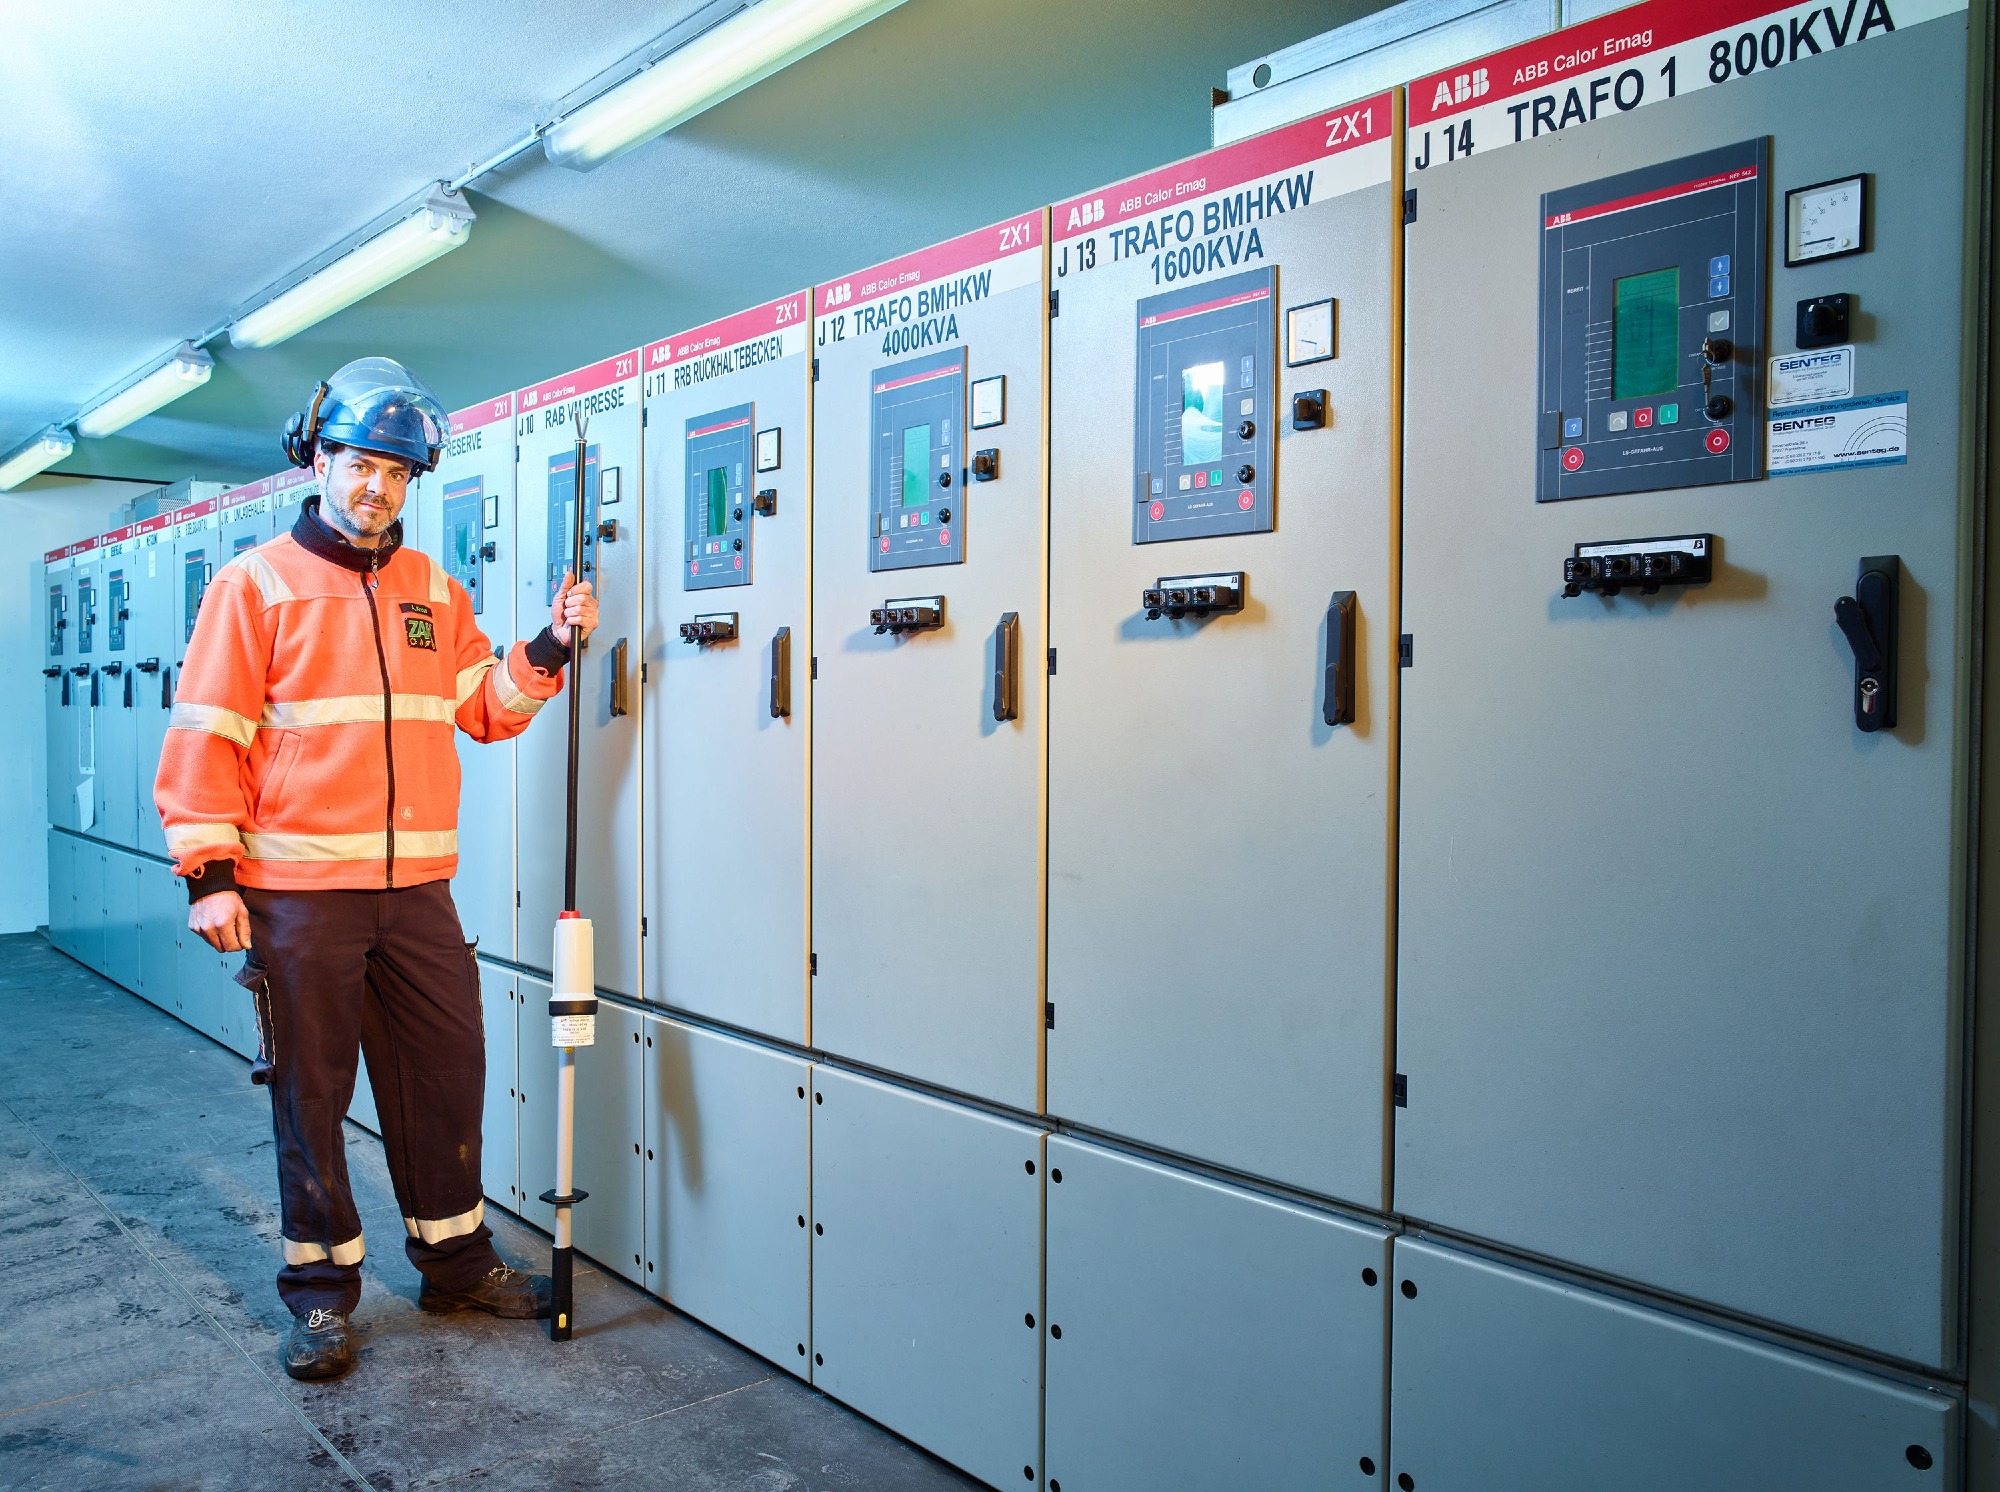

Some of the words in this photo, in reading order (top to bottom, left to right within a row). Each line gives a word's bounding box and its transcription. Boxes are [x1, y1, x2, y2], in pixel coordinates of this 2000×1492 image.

[1415, 132, 1430, 170] J
[1444, 118, 1474, 163] 14
[1507, 68, 1644, 143] TRAFO
[1660, 55, 1677, 97] 1
[1708, 0, 1896, 84] 800KVA
[1431, 67, 1490, 112] ABB
[1512, 60, 1549, 87] ABB
[1553, 46, 1598, 72] Calor
[1603, 28, 1653, 57] Emag
[1325, 107, 1373, 148] ZX1
[1067, 198, 1105, 231] ABB
[1119, 197, 1142, 214] ABB
[1144, 188, 1173, 206] Calor
[1176, 177, 1206, 199] Emag
[1553, 213, 1572, 225] ABB
[999, 221, 1030, 251] ZX1
[1057, 246, 1068, 277] J
[1077, 237, 1096, 271] 13
[1109, 210, 1195, 262] TRAFO
[1203, 170, 1315, 237] BMHKW
[1151, 227, 1264, 285] 1600KVA
[825, 283, 851, 308] ABB
[861, 284, 877, 297] ABB
[878, 277, 897, 291] Calor
[900, 269, 920, 285] Emag
[775, 300, 798, 325] ZX1
[818, 321, 826, 346] J
[831, 315, 845, 342] 12
[854, 295, 912, 335] TRAFO
[918, 269, 992, 318] BMHKW
[652, 344, 671, 366] ABB
[677, 346, 690, 357] ABB
[690, 341, 704, 354] Calor
[705, 336, 720, 347] Emag
[882, 313, 959, 357] 4000KVA
[616, 358, 632, 378] ZX1
[1780, 354, 1841, 370] SENTEG
[646, 376, 652, 398] J
[656, 372, 665, 395] 11
[674, 364, 691, 390] RRB
[494, 401, 508, 418] ZX1
[519, 418, 524, 436] J
[526, 414, 534, 434] 10
[546, 406, 565, 429] RAB
[584, 386, 624, 418] PRESSE
[522, 390, 538, 408] ABB
[1773, 416, 1836, 432] SENTEG
[446, 431, 482, 459] RESERVE
